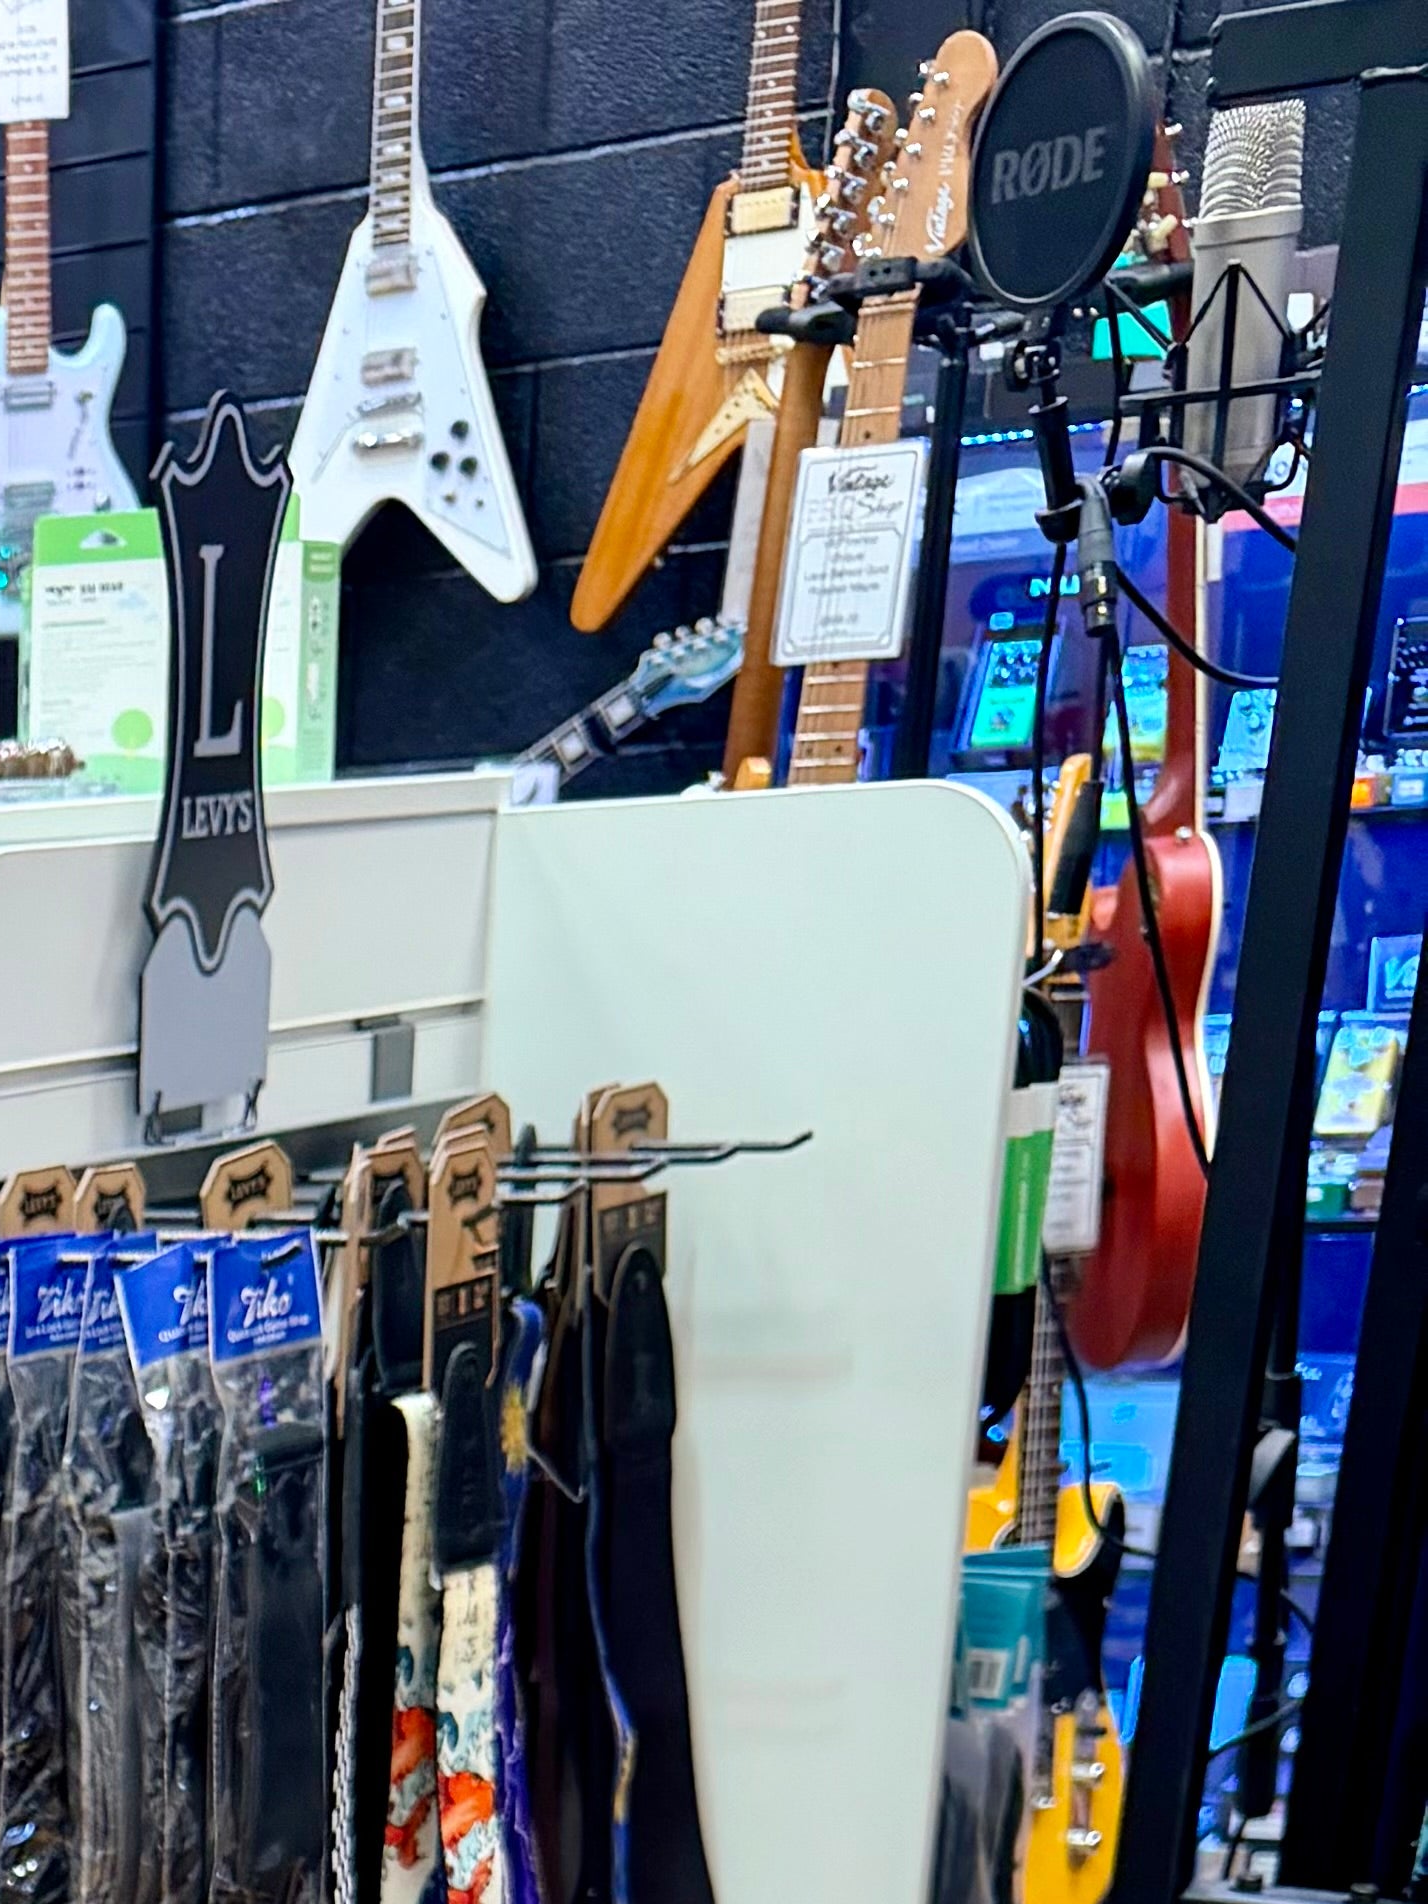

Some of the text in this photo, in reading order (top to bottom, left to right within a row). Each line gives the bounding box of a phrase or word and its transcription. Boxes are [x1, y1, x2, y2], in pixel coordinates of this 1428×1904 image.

[991, 126, 1106, 205] RØDE
[193, 544, 242, 757] L
[173, 1280, 207, 1326] Tik
